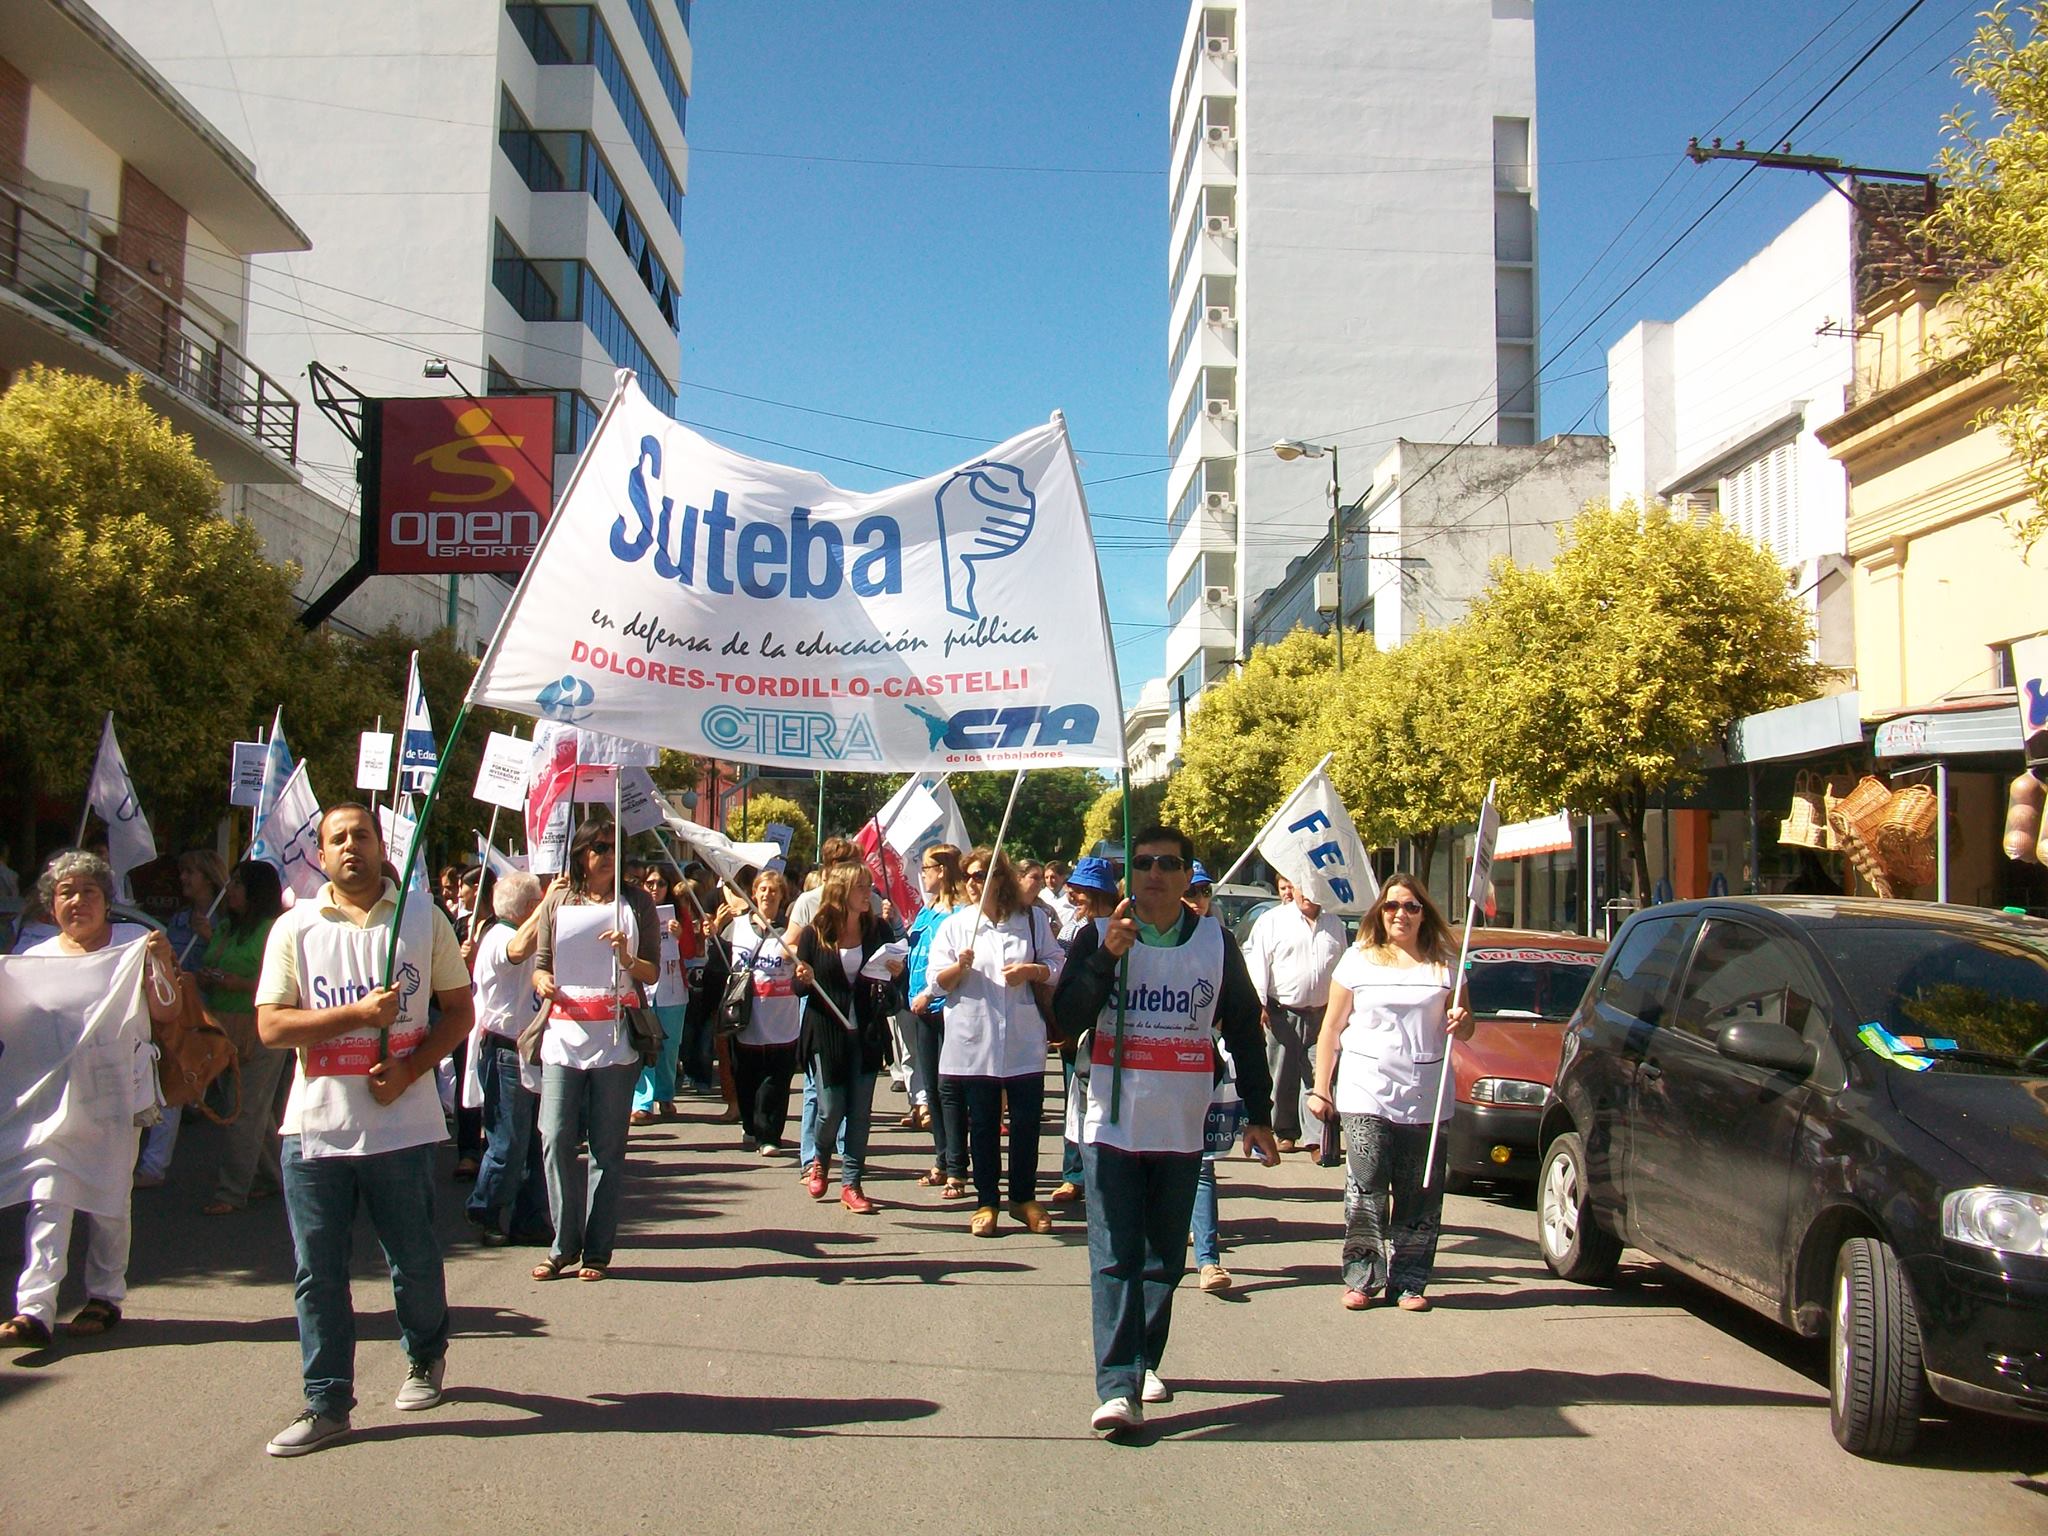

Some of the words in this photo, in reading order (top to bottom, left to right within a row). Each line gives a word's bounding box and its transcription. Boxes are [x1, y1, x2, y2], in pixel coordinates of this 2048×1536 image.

[390, 510, 539, 558] open
[609, 434, 902, 601] Suteba
[438, 545, 536, 558] SPORTS
[591, 608, 615, 630] en
[623, 611, 712, 653] defensa
[721, 631, 749, 656] de
[759, 632, 786, 658] la
[795, 629, 929, 658] educación
[943, 616, 1039, 658] pública
[700, 703, 884, 760] CTERA
[942, 703, 1101, 751] CTA
[945, 753, 961, 763] de
[964, 753, 982, 763] los
[986, 750, 1064, 762] trabajadores
[1288, 809, 1354, 904] FEB
